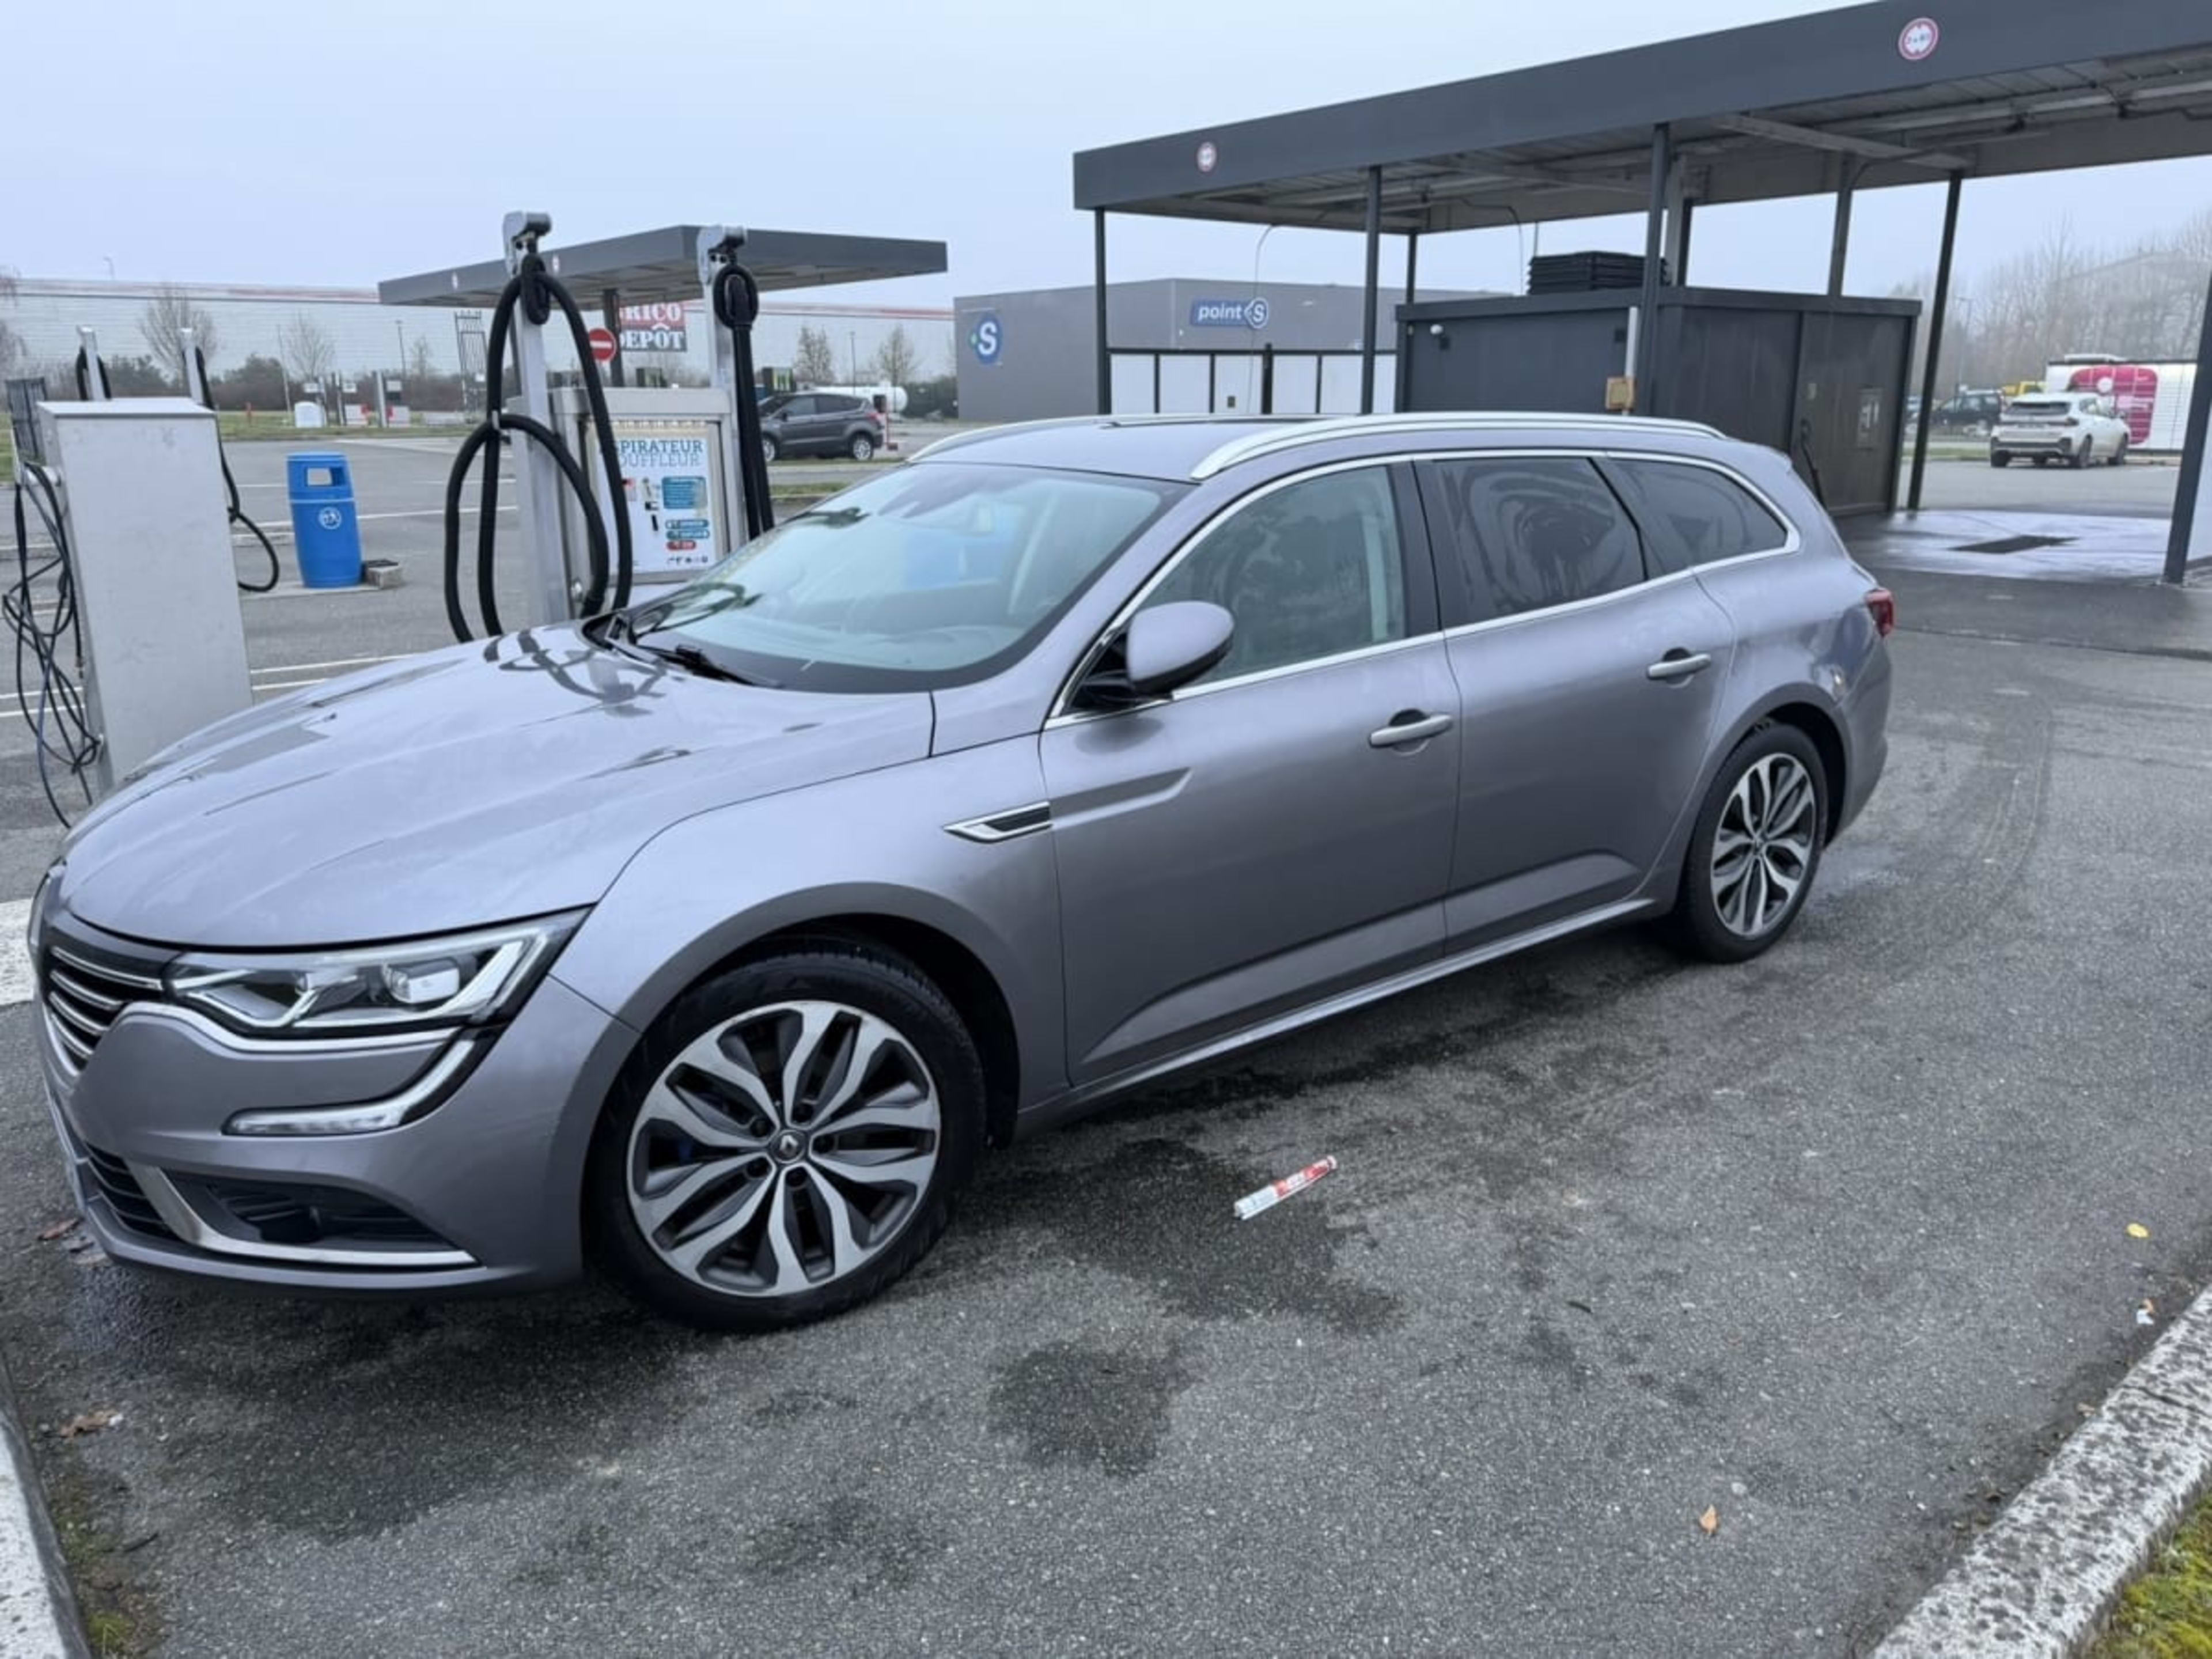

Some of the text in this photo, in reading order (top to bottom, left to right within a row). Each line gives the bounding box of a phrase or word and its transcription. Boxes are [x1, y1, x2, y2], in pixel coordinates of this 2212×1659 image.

[1197, 302, 1265, 323] point S
[978, 321, 997, 355] S
[619, 440, 703, 453] PIRATEUR
[620, 453, 702, 467] OUFFLEUR
